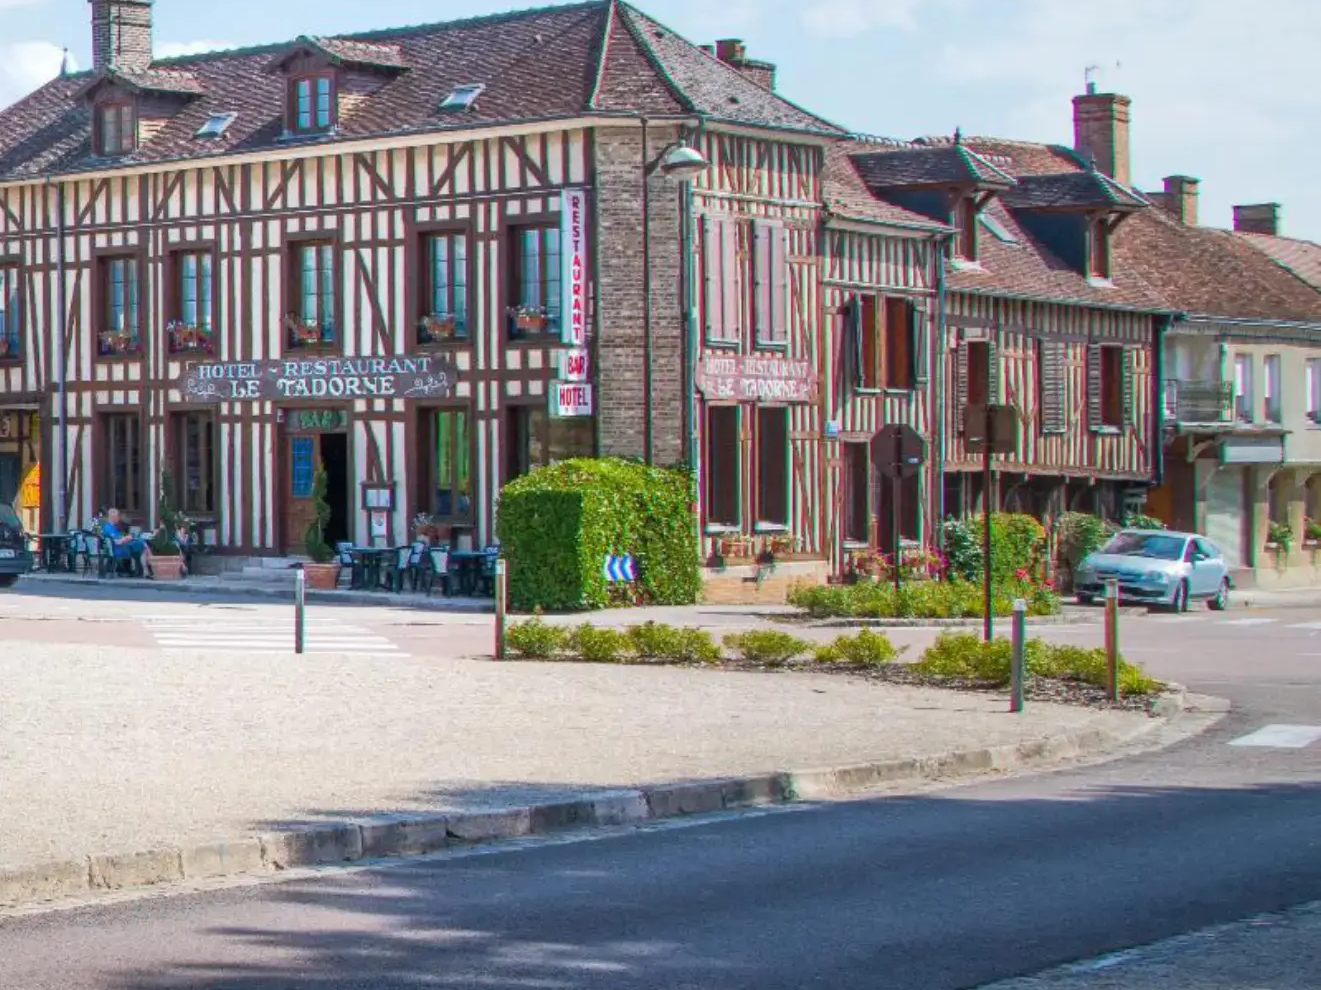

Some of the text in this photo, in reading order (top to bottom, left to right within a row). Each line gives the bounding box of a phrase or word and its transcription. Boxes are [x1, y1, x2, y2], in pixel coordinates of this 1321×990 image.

[571, 197, 582, 341] RESTAURANT
[197, 363, 263, 379] HOTEL
[283, 357, 432, 378] RESTAURANT
[568, 355, 585, 375] BAR
[745, 359, 807, 377] RESTAURANT
[229, 378, 396, 399] LE TADORNE
[559, 387, 589, 407] HOTEL
